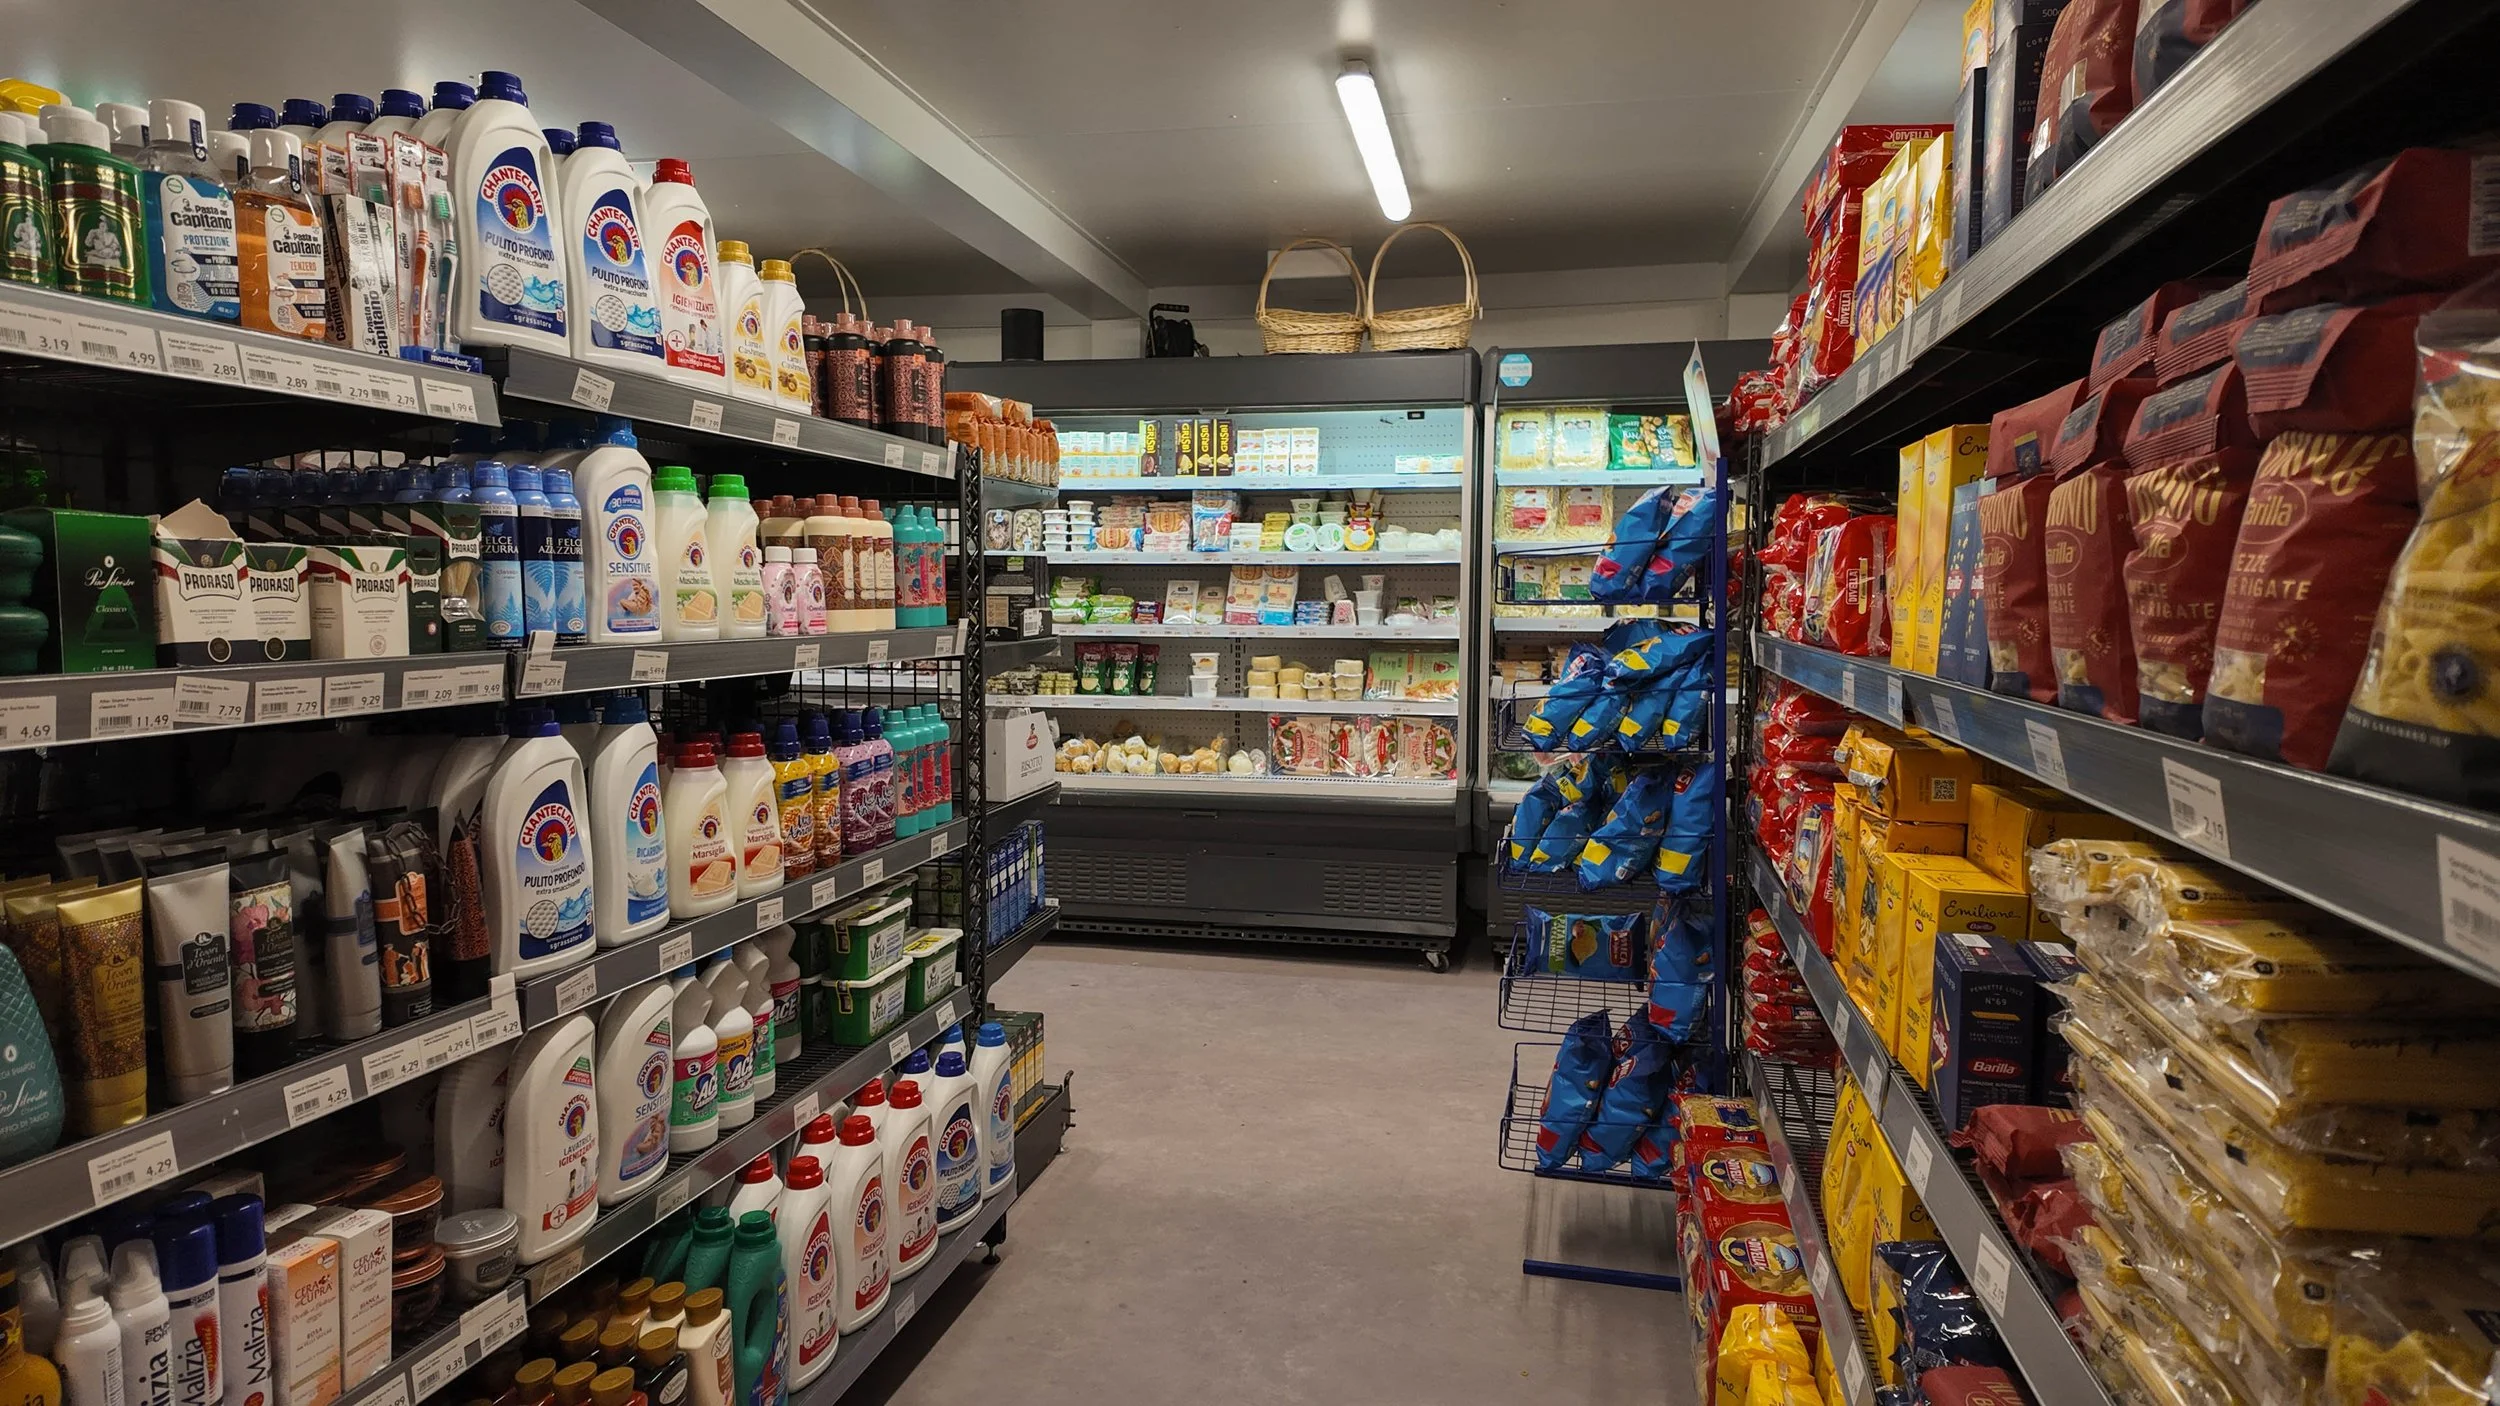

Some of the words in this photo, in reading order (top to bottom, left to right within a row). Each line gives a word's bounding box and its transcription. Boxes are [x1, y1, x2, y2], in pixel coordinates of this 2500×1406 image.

[1894, 130, 1931, 141] DIVELLA
[482, 167, 544, 215] CHANTECLAIR
[170, 212, 232, 230] Capitano
[586, 206, 641, 249] CHANTECLAIR
[183, 234, 231, 247] PROTEZIONE
[273, 240, 322, 255] Capitano
[357, 220, 373, 262] CARBONE
[484, 231, 519, 254] PULITO
[518, 243, 555, 263] PROFONDO
[498, 251, 516, 262] extra
[664, 236, 710, 275] CHANTECLAIR
[290, 261, 317, 271] ZENZERO
[591, 266, 620, 283] PULITO
[603, 282, 619, 292] extra
[672, 292, 715, 313] IGIENIZZANTE
[1840, 291, 1851, 326] DIVELLA
[513, 314, 552, 329] sgrassatore
[620, 339, 653, 352] sgrassatore
[609, 516, 645, 541] CHANTECLAIR
[451, 543, 478, 554] PRORASO
[1983, 545, 2006, 567] arilla
[2047, 541, 2074, 565] arilla
[609, 562, 652, 574] SENSITIVE
[2236, 552, 2271, 574] EZZE
[184, 573, 235, 591] PRORASO
[250, 576, 295, 594] PRORASO
[355, 577, 395, 593] PRORASO
[413, 578, 437, 588] PRORASO
[1848, 570, 1858, 603] DIVELLA
[95, 604, 128, 614] Classico
[1307, 733, 1317, 759] PINSA
[522, 803, 577, 846] CHANTECLAIR
[746, 831, 776, 845] Marsiglia
[692, 846, 726, 860] Marsiglia
[524, 875, 554, 888] PULITO
[554, 862, 586, 886] PROFONDO
[535, 887, 552, 896] extra
[1944, 899, 2022, 920] Emiliane
[550, 932, 583, 951] sgrassatore
[191, 945, 220, 961] Tesori
[187, 954, 226, 971] d'Oriente
[104, 966, 134, 981] Tesori
[1969, 984, 2003, 994] PENNETTE
[2005, 985, 2025, 997] LISCE
[773, 998, 799, 1022] ACE
[1984, 997, 2008, 1007] N°69
[1973, 1061, 2017, 1075] Barilla
[563, 1133, 593, 1156] LAVATRICE
[940, 1167, 957, 1178] PULITO
[352, 1252, 375, 1271] CERA
[357, 1255, 388, 1276] CUPRA
[294, 1278, 319, 1301] CERA
[300, 1283, 333, 1305] CUPRA
[243, 1305, 268, 1386] Malizia
